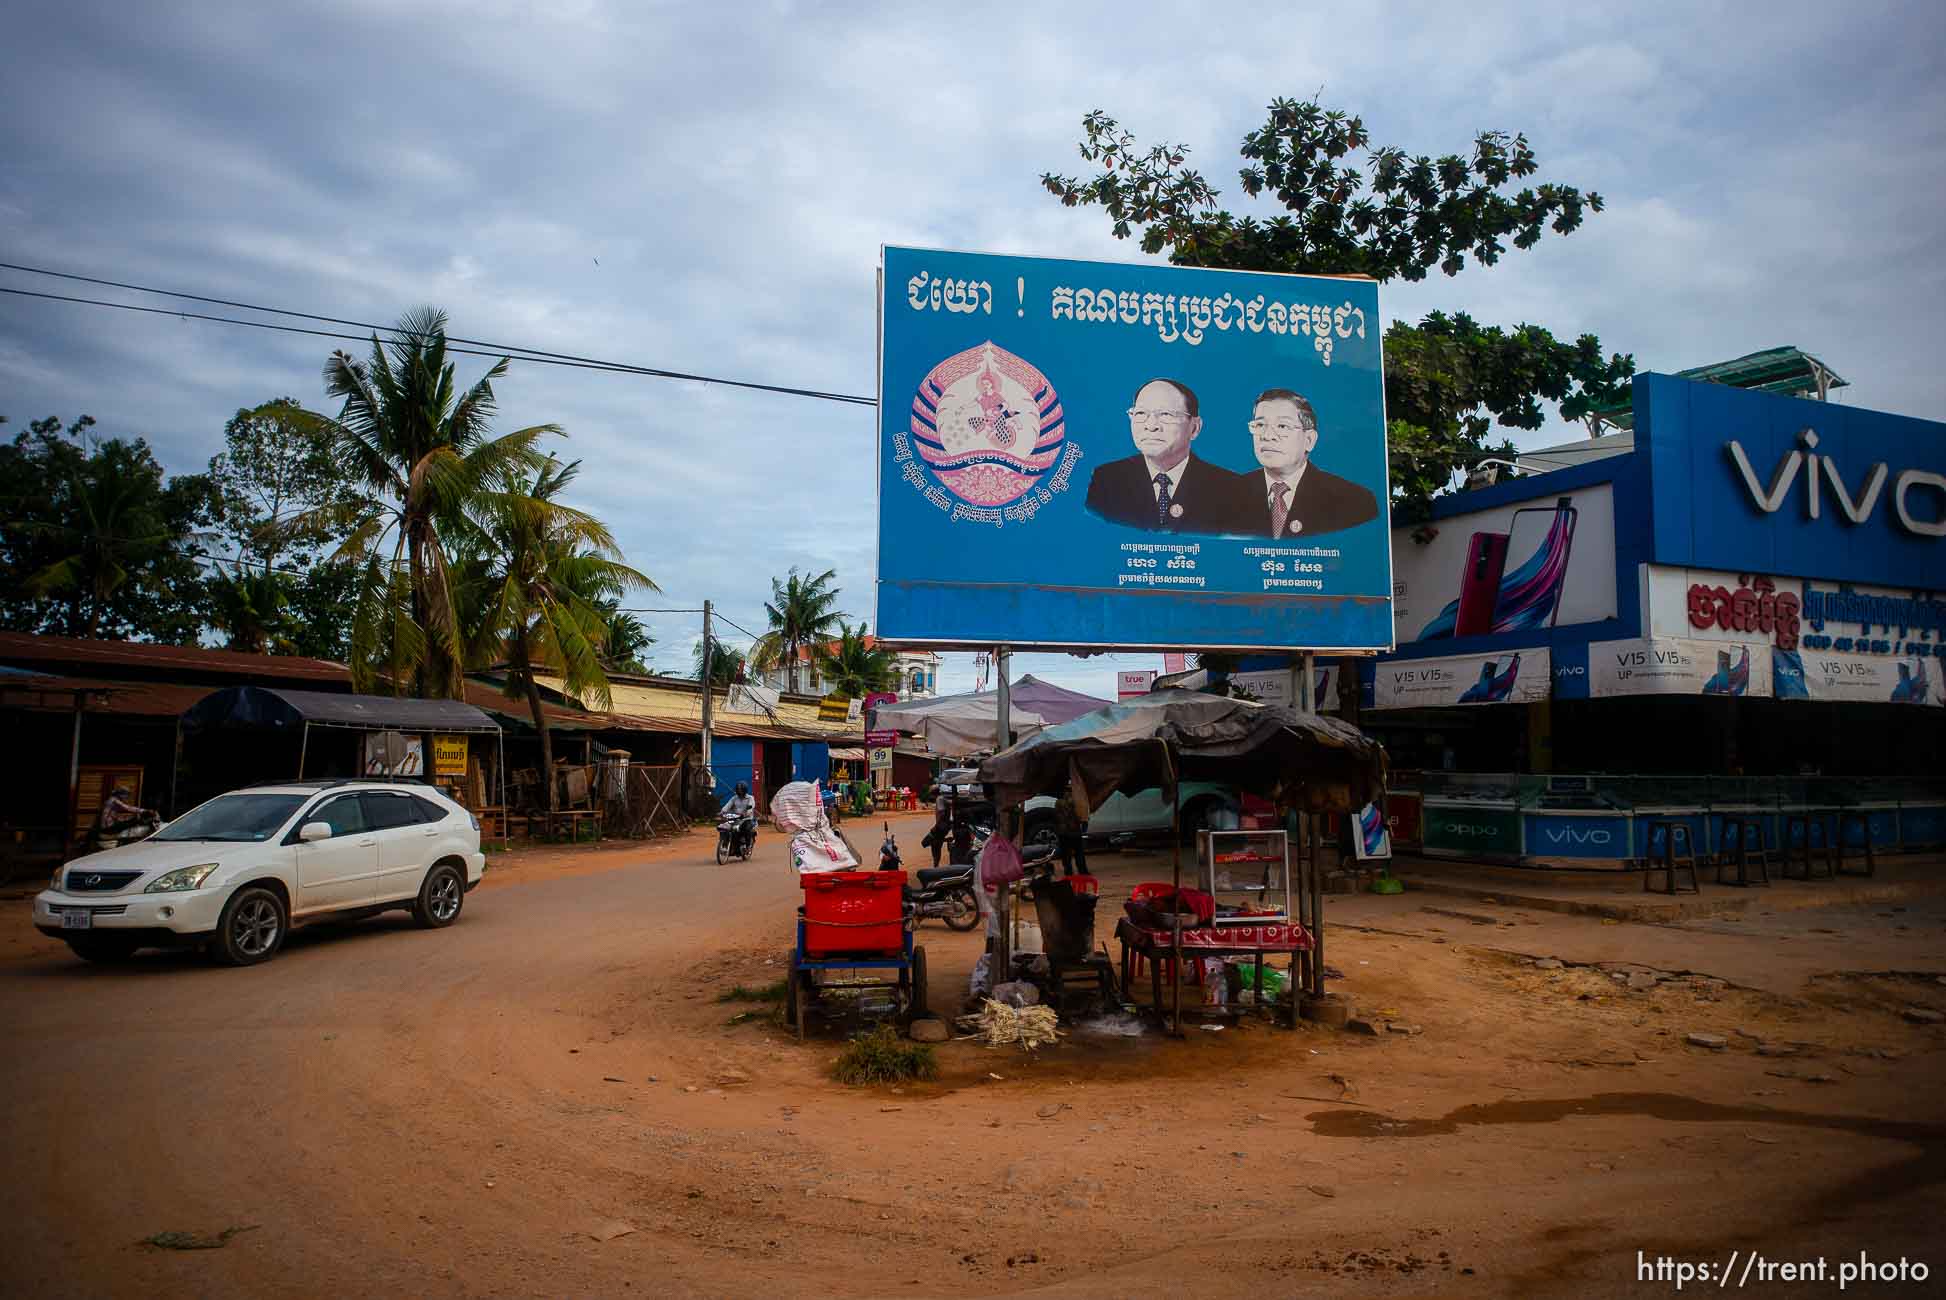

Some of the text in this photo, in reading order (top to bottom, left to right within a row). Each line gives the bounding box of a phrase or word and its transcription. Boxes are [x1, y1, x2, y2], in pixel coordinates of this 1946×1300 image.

[908, 271, 992, 315] ជយោ
[1052, 286, 1365, 367] គណបក្សប្រជាជនកម្ពុជា
[1729, 428, 1946, 536] vivo
[1617, 652, 1645, 666] V15
[1655, 651, 1679, 664] V15
[1394, 671, 1414, 682] V15
[1421, 669, 1441, 681] V15
[1821, 662, 1841, 674] V15
[1845, 663, 1865, 675] V15
[1125, 675, 1144, 683] true
[874, 751, 886, 760] 99
[1447, 823, 1498, 837] oppo
[1546, 825, 1611, 844] vivo
